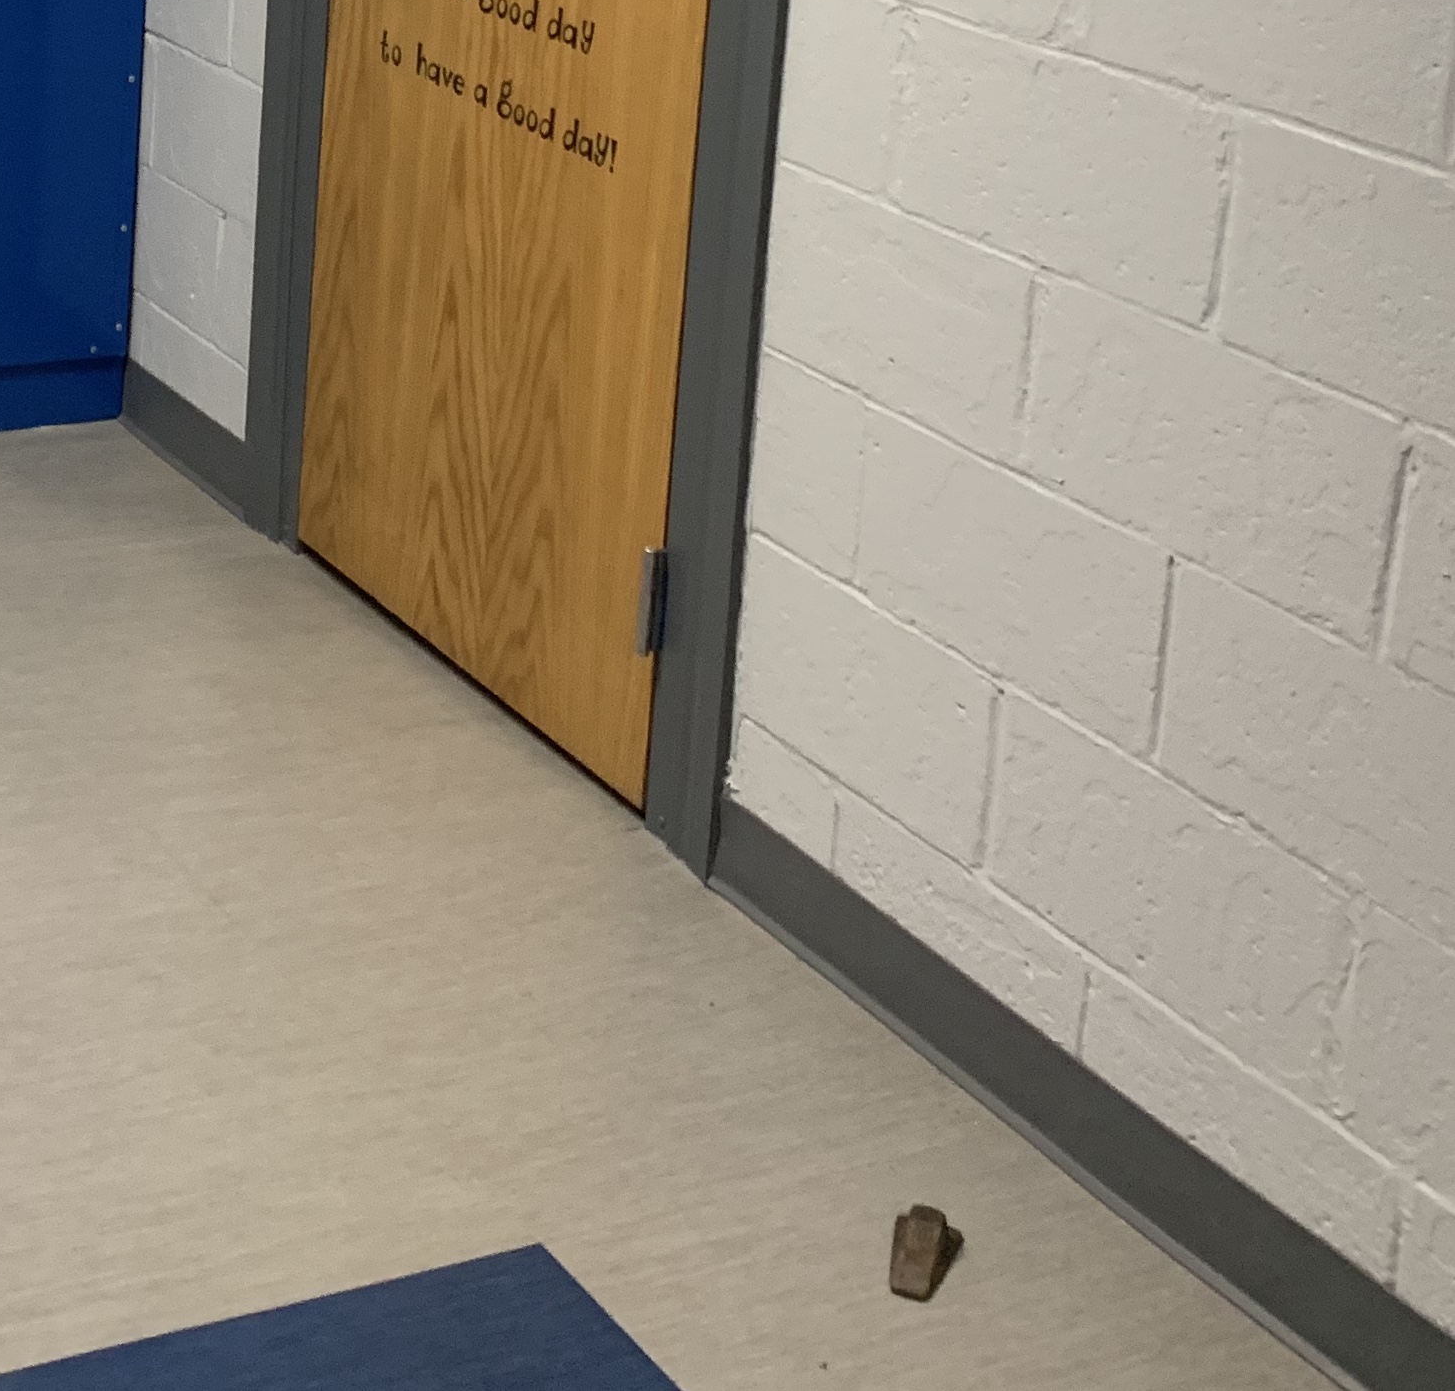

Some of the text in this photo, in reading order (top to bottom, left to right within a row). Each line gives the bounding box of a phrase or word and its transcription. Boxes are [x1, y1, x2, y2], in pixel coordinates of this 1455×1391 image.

[547, 7, 596, 54] day
[380, 30, 618, 173] to have a good day!
